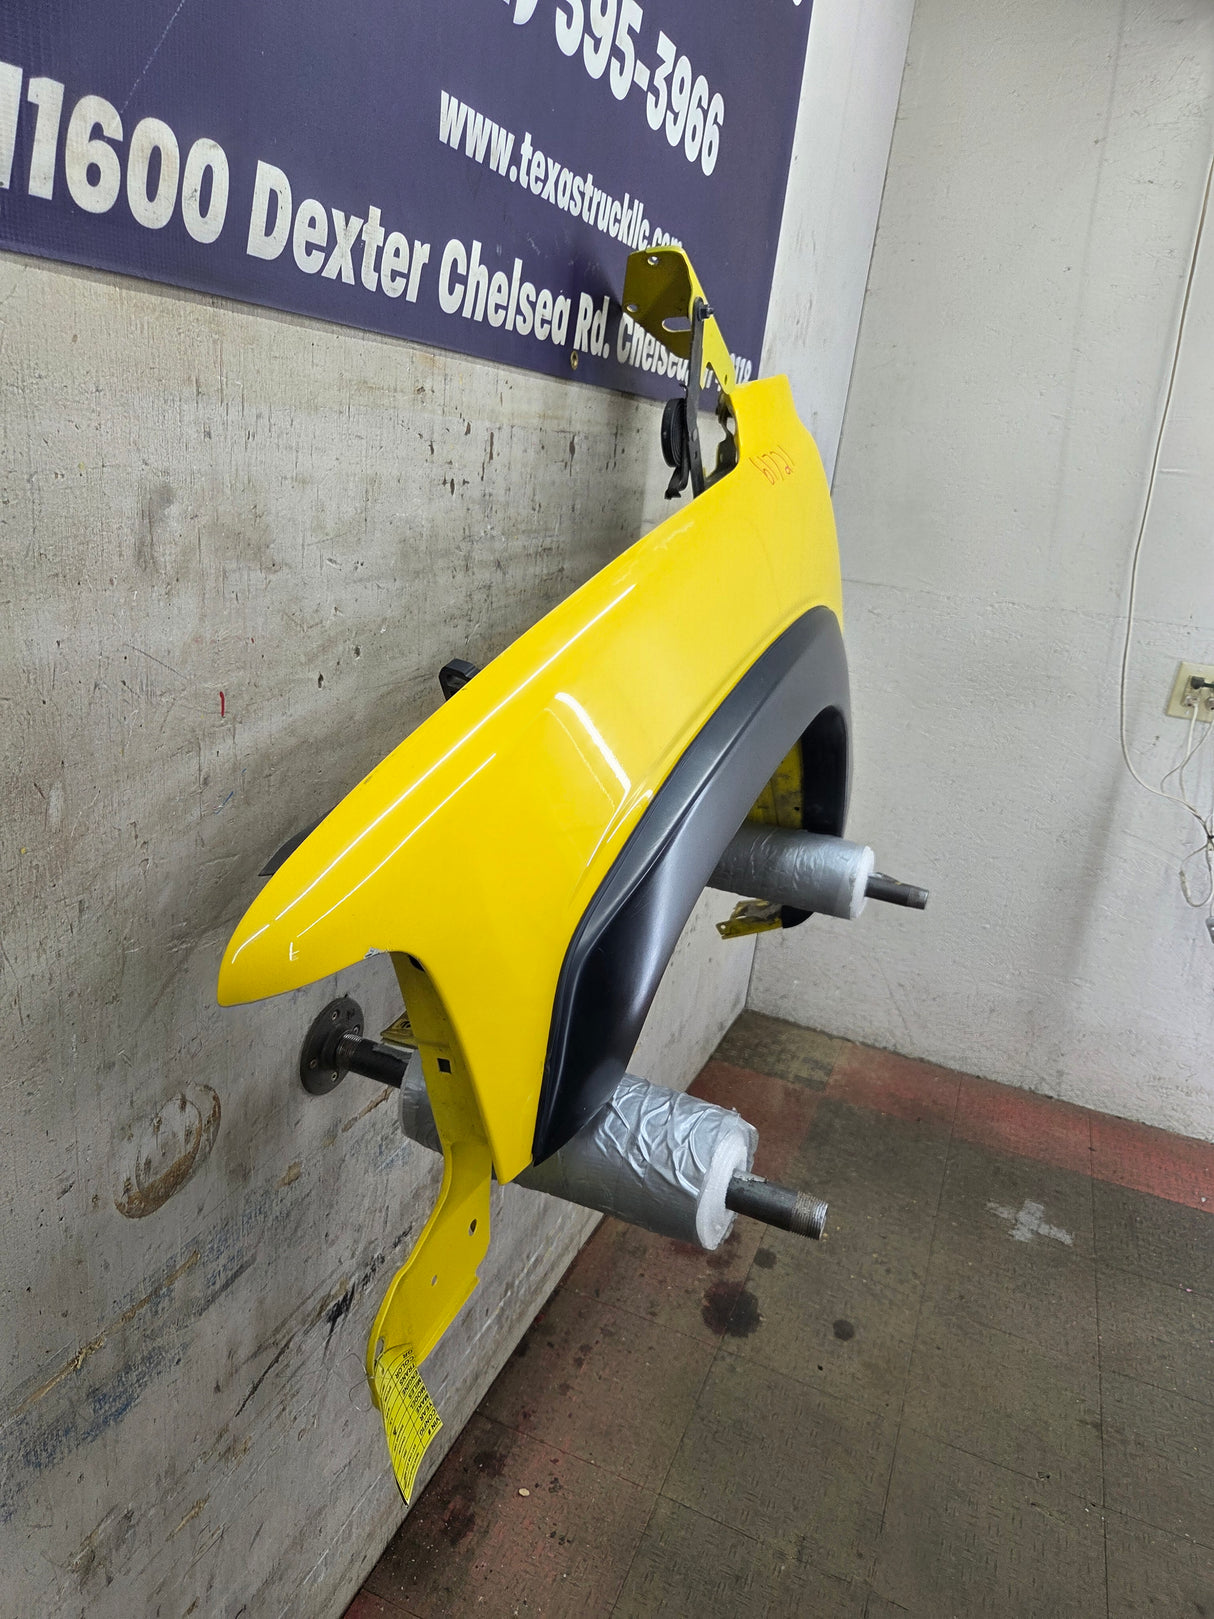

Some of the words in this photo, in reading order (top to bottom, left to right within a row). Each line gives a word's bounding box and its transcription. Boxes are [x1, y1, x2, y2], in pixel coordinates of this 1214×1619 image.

[246, 160, 431, 303] Dexter
[438, 239, 571, 346] Chelsea
[573, 292, 611, 359] Rd.
[395, 1356, 415, 1379] COLOR
[399, 1363, 415, 1387] TRANS
[402, 1370, 418, 1395] ENGINE
[410, 1385, 426, 1409] MODEL
